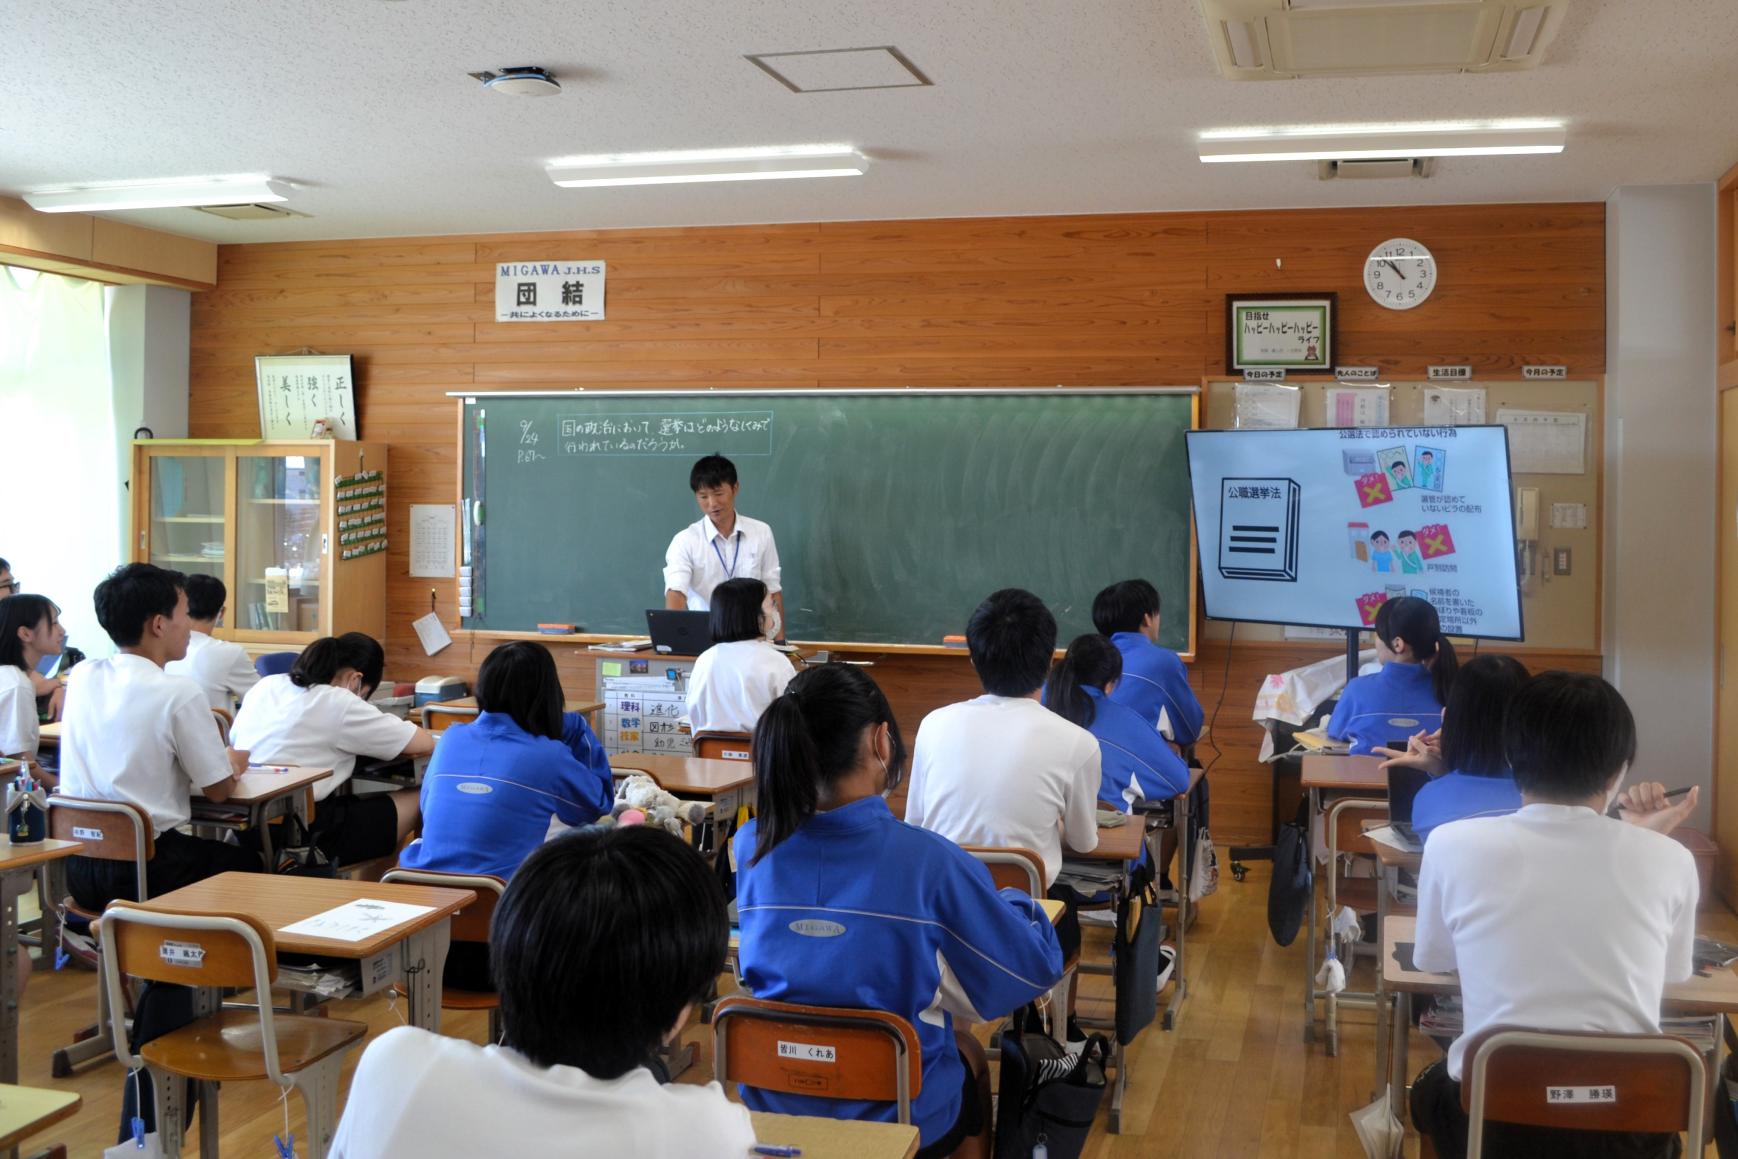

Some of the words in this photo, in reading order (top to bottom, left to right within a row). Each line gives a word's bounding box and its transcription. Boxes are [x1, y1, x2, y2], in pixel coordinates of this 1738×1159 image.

[1395, 247, 1406, 256] 12
[500, 264, 560, 277] MIGAWA
[1373, 271, 1381, 279] 9
[1420, 270, 1426, 278] 3
[1376, 281, 1384, 290] 8
[1416, 281, 1423, 289] 4
[1385, 290, 1391, 298] 7
[1396, 293, 1404, 301] 6
[1408, 290, 1415, 298] 5
[1245, 311, 1269, 321] 目指せ
[1244, 321, 1318, 334] ハッピーハッピーハッピー
[1298, 336, 1320, 344] ライフ
[1246, 370, 1283, 379] 今日の予定
[1432, 368, 1467, 377] 生活目標
[1525, 368, 1564, 377] 今月の予定
[1228, 486, 1282, 500] 公職選挙法
[1437, 607, 1484, 617] ぼりや看板の
[620, 701, 640, 713] 理科
[649, 703, 680, 717] 進化
[621, 717, 640, 729] 数学
[780, 1043, 798, 1056] 皆川
[808, 1047, 834, 1059] くれあ
